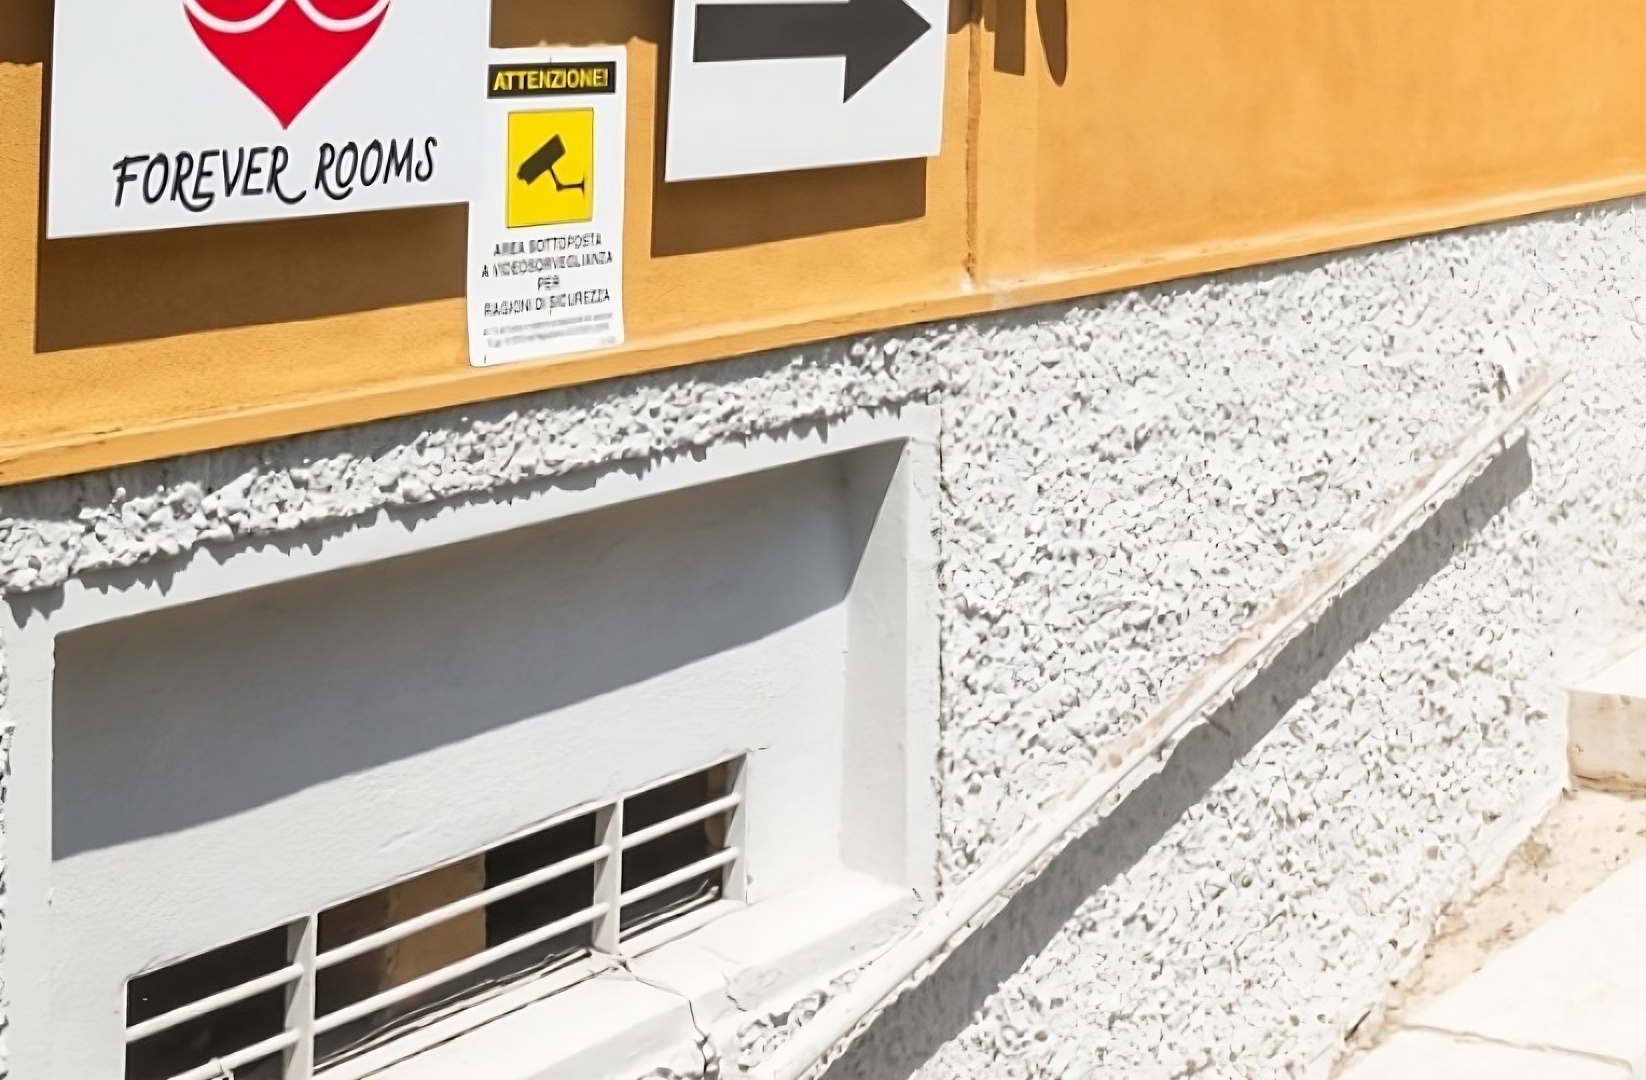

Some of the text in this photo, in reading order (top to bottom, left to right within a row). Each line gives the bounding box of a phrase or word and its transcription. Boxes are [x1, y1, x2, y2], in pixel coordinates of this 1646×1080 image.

[492, 68, 609, 91] ATTENZIONE!
[112, 136, 438, 213] FOREVER ROOMS
[528, 232, 602, 254] SOTTOPOSTA
[482, 264, 490, 278] A
[537, 275, 560, 291] PER
